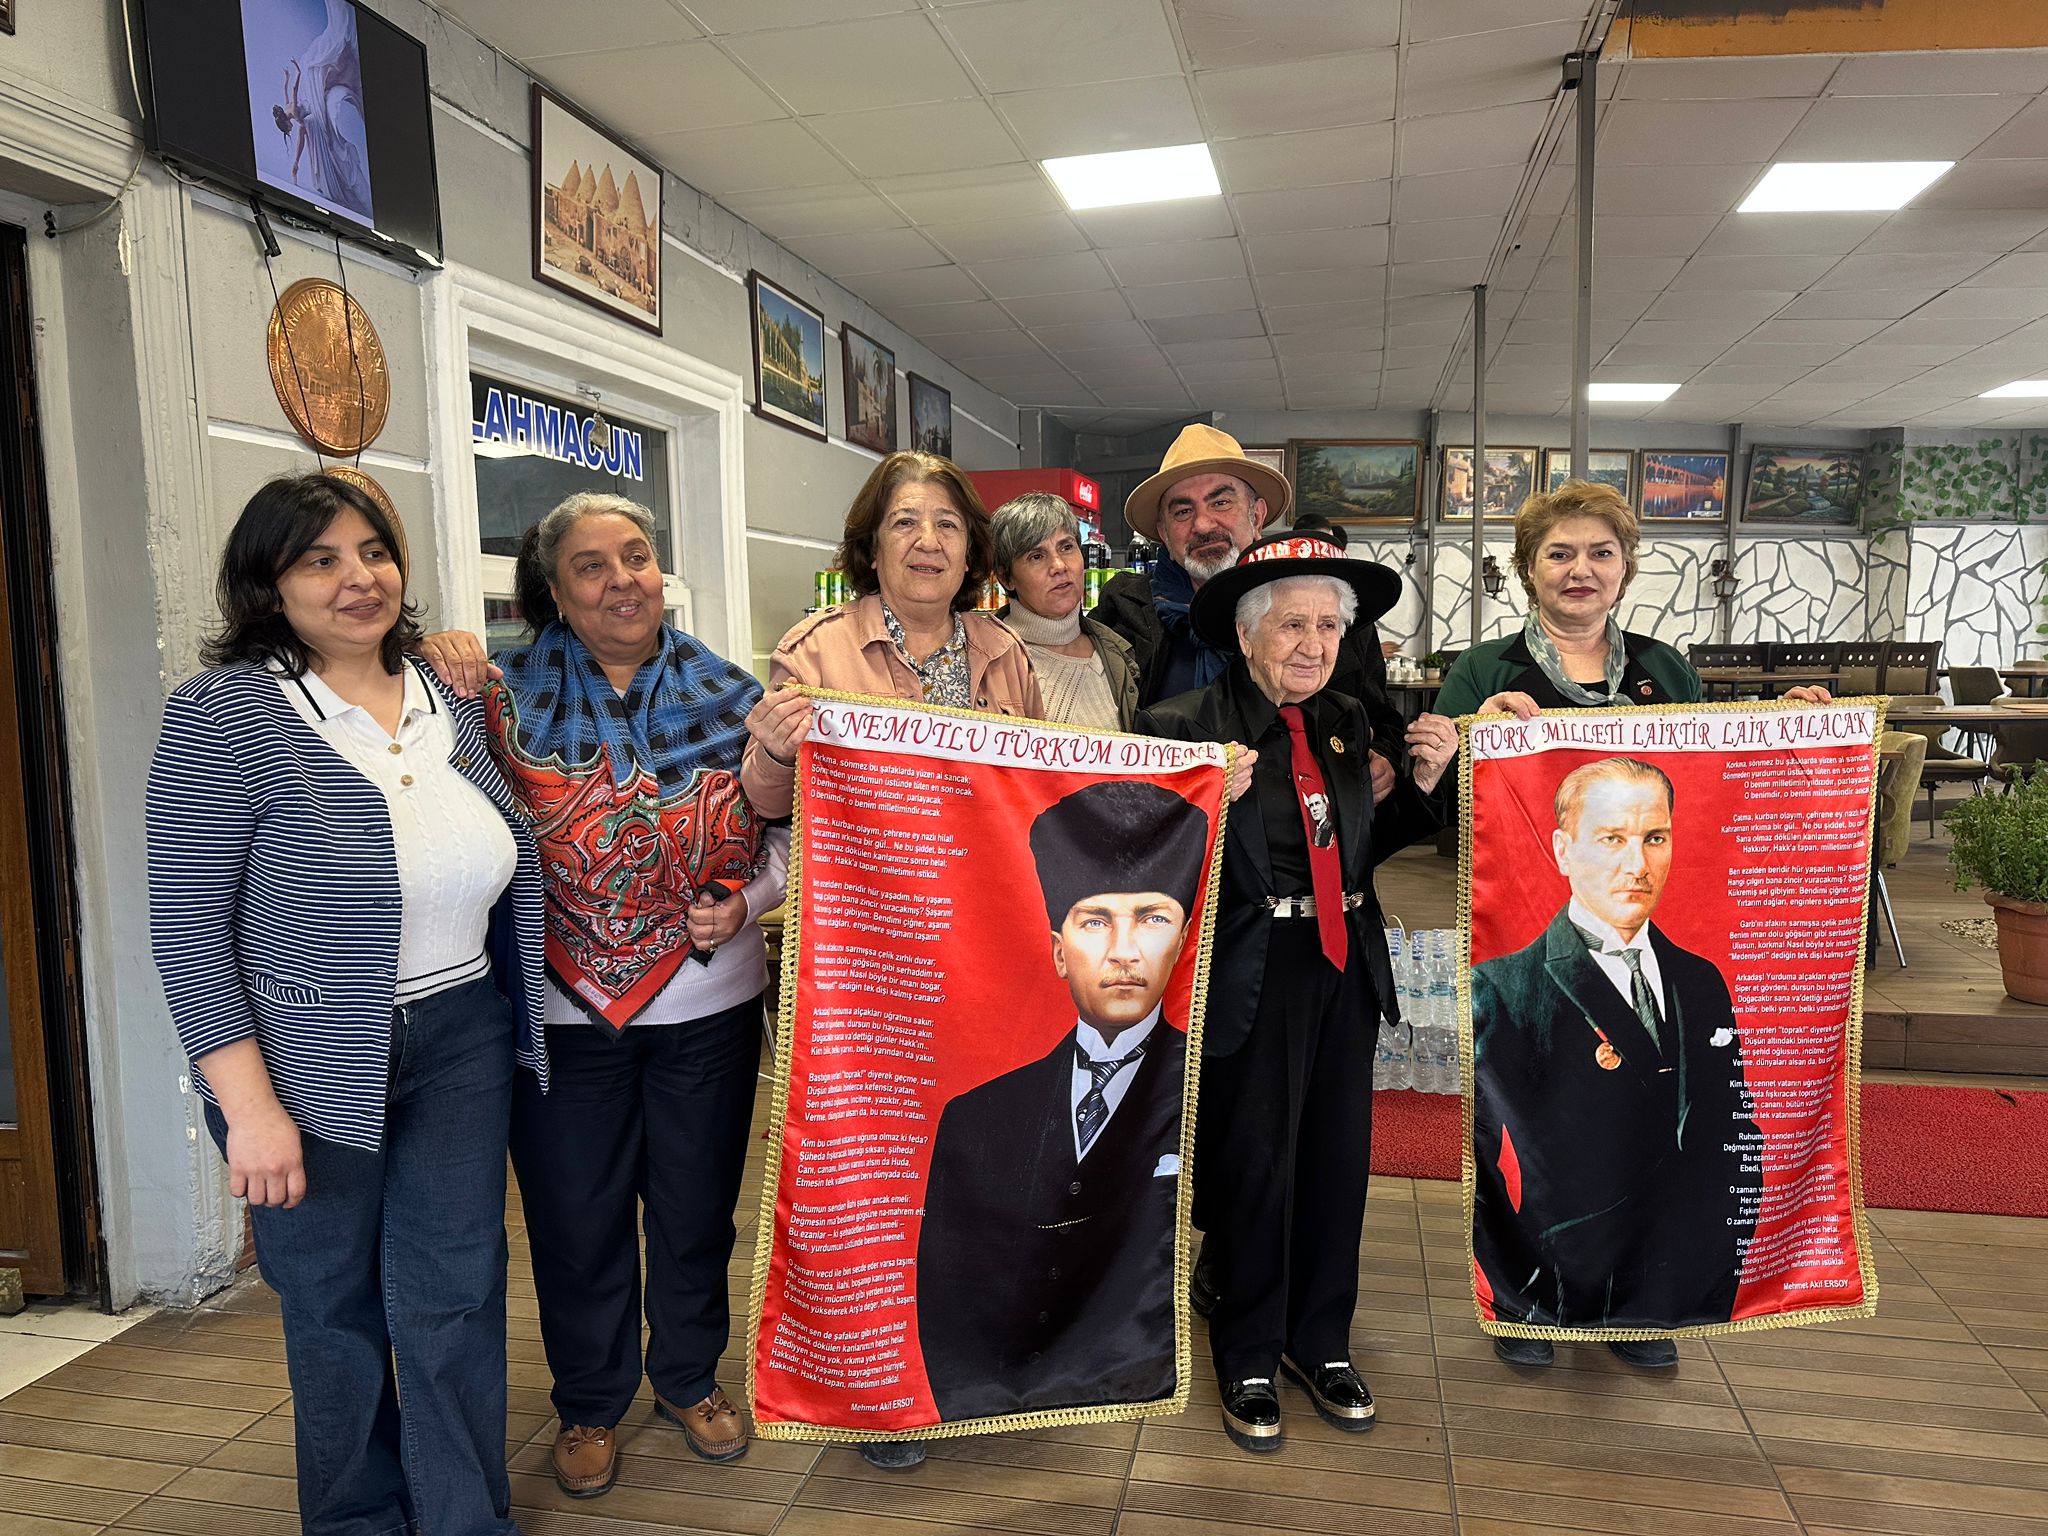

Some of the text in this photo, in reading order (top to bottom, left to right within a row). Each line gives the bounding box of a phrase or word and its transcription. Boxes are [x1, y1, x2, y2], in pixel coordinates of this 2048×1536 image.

[1475, 712, 1871, 753] TÜRK MİLLETİ LAİKTİR LAİK KALACAK
[839, 711, 987, 753] NEMUTLU
[994, 729, 1112, 767] TÜRKÜM
[1121, 739, 1217, 768] DİYENE
[840, 760, 869, 771] sönmez
[869, 763, 879, 772] bu
[916, 769, 935, 779] yüzen
[1752, 770, 1786, 780] yurdumun
[817, 778, 838, 789] benim
[848, 774, 884, 785] yurdumun
[1751, 781, 1771, 789] benim
[855, 799, 877, 810] benim
[832, 818, 856, 830] kurban
[884, 829, 912, 839] çehrene
[912, 833, 921, 842] ey
[922, 833, 937, 841] nazlı
[842, 834, 863, 845] ırkıma
[864, 838, 874, 846] bir
[894, 842, 904, 851] Ne
[905, 843, 914, 852] bu
[938, 846, 947, 855] bu
[823, 842, 844, 853] olmaz
[845, 846, 872, 859] dökülen
[835, 856, 858, 868] Hakk'a
[844, 882, 867, 894] beridir
[1746, 878, 1765, 887] çılgın
[842, 894, 859, 904] bana
[860, 898, 880, 908] zincir
[1824, 897, 1849, 907] sığmam
[873, 912, 902, 925] Bendimi
[1806, 941, 1825, 950] böyle
[838, 982, 863, 992] dediğin
[864, 984, 875, 993] tek
[876, 986, 889, 996] dişi
[890, 988, 913, 1001] kalmış
[1740, 1090, 1765, 1100] Şüheda
[879, 1133, 900, 1142] olmaz
[901, 1134, 908, 1142] ki
[1762, 1164, 1795, 1174] yurdumun
[1810, 1280, 1823, 1289] Akif
[1824, 1280, 1849, 1288] ERSOY
[802, 1359, 815, 1369] hür
[801, 1370, 824, 1384] Hakk'a
[851, 1398, 914, 1412] Mehmet Akif ERSOY
